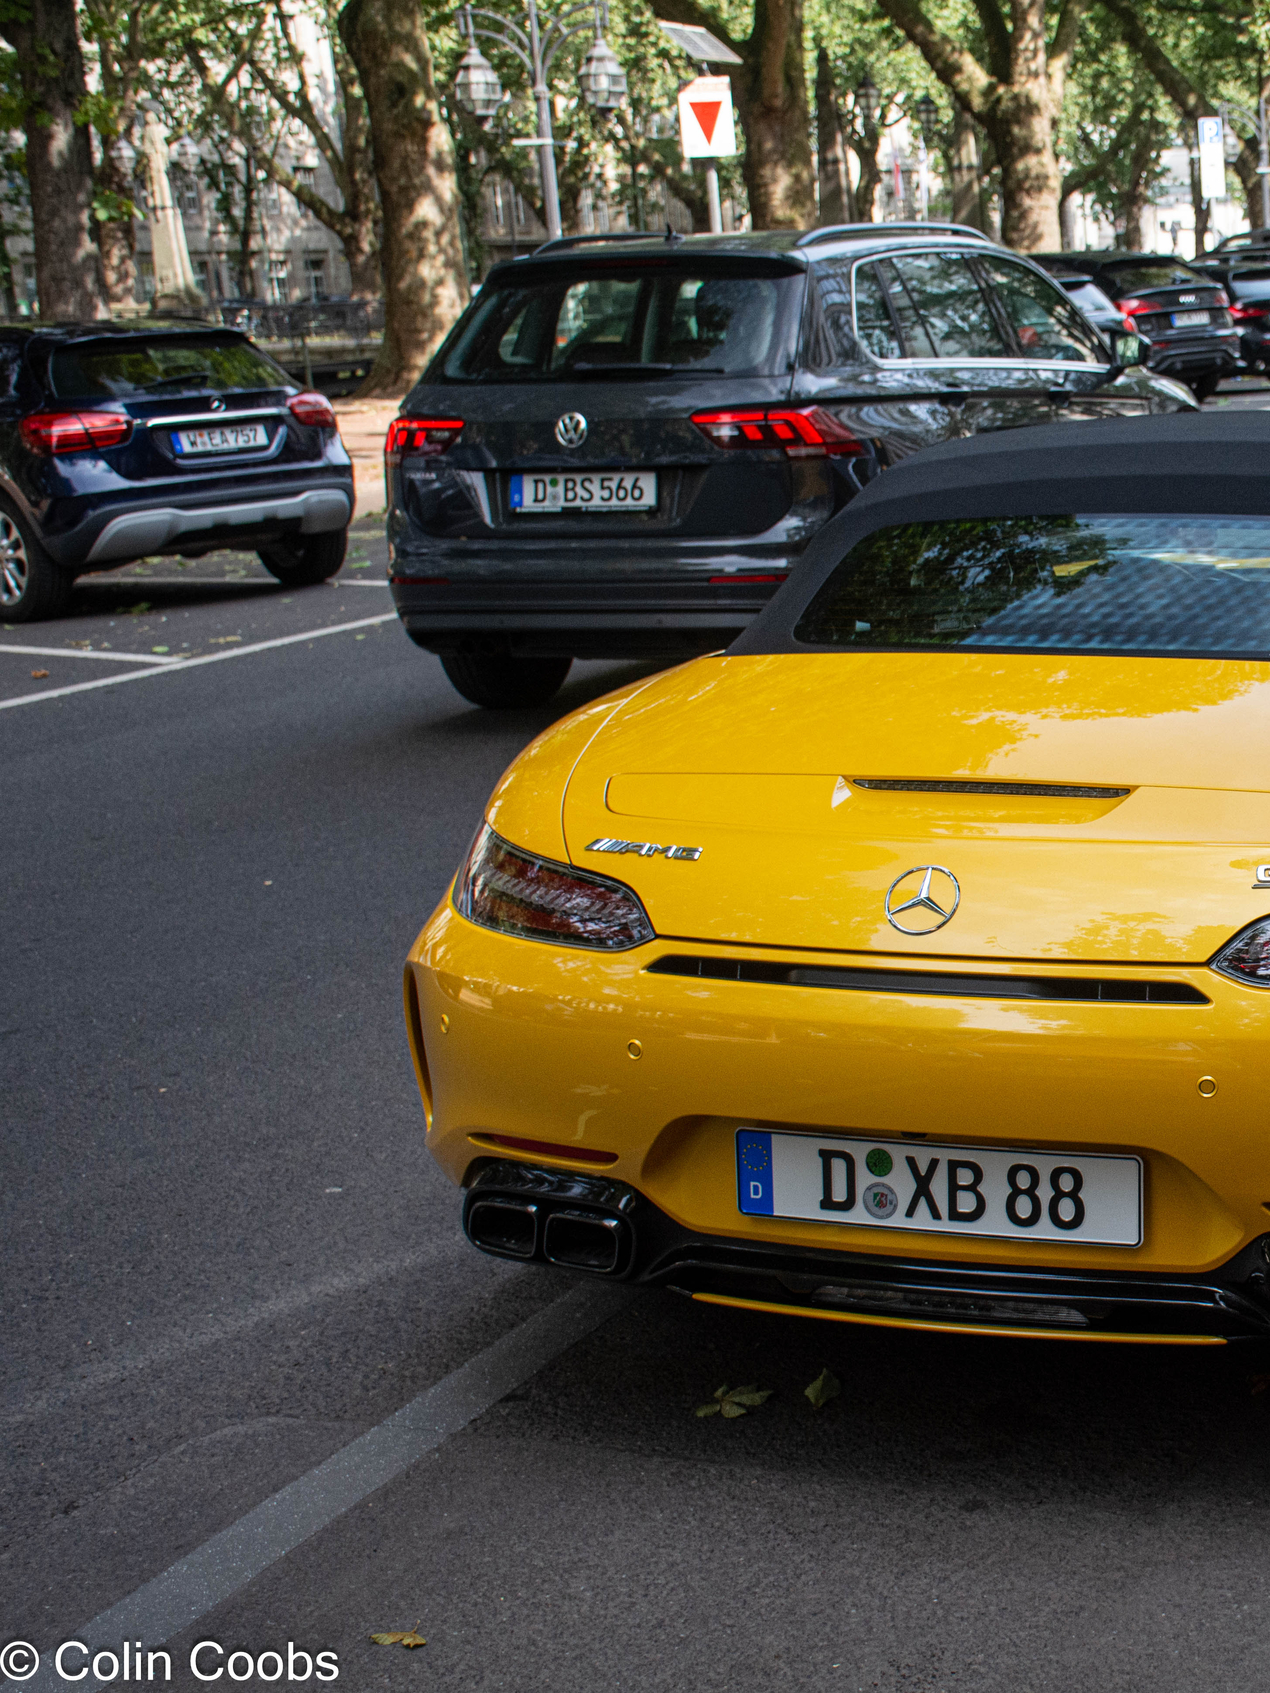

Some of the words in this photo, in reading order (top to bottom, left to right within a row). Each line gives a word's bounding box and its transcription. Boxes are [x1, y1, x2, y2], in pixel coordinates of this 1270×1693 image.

[1203, 121, 1218, 143] P
[207, 429, 230, 447] EA
[231, 426, 257, 444] 757
[533, 479, 547, 503] D
[564, 477, 594, 503] BS
[600, 477, 644, 502] 566
[619, 842, 703, 861] AMG
[750, 1181, 762, 1199] D
[819, 1148, 857, 1212] D
[905, 1155, 987, 1223] XB
[1006, 1163, 1085, 1231] 88
